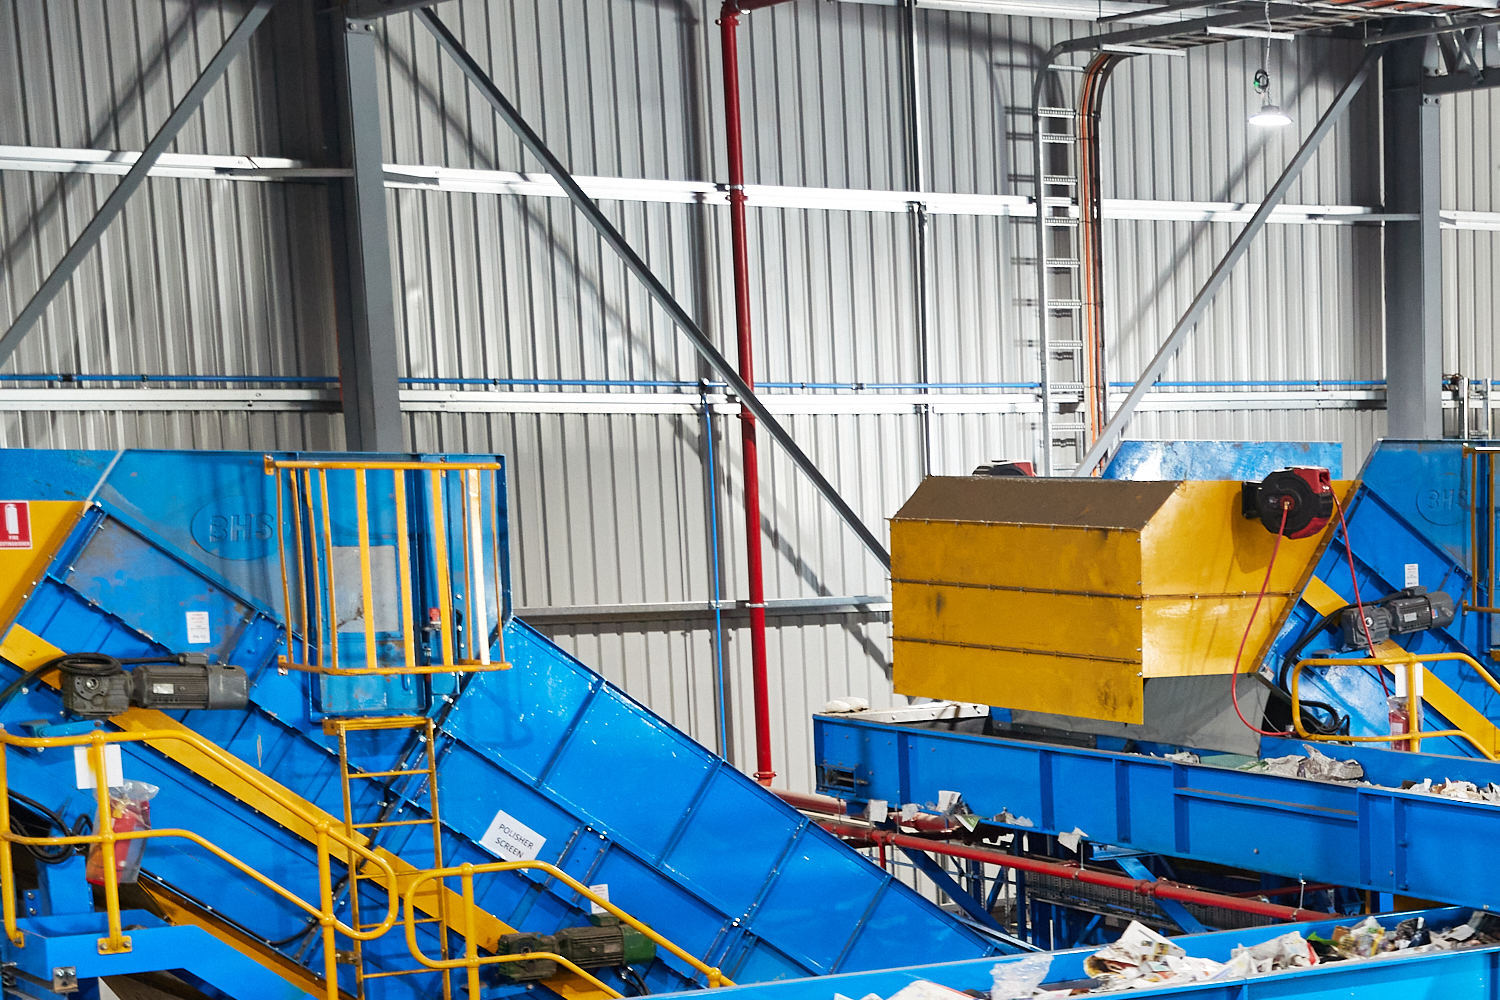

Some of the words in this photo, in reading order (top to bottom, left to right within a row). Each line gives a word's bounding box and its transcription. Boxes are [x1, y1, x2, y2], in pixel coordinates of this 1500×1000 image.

[209, 513, 274, 543] BHS
[495, 837, 524, 858] SCREEN
[499, 823, 534, 849] POLISHER
